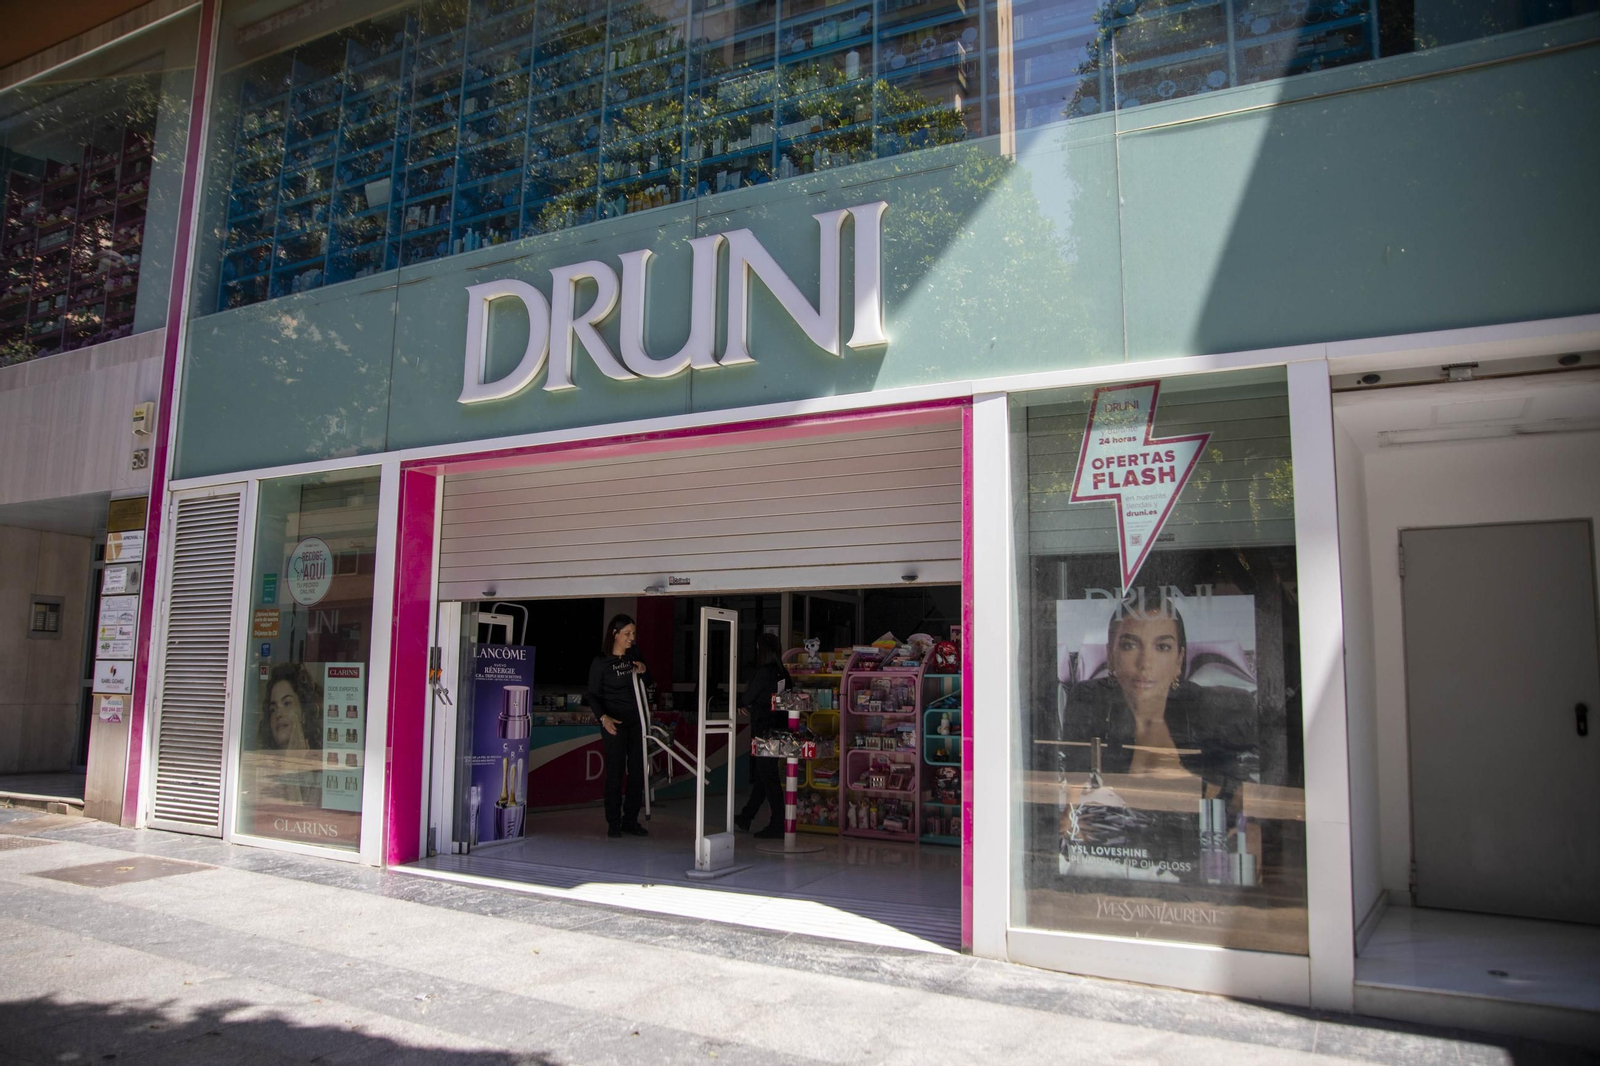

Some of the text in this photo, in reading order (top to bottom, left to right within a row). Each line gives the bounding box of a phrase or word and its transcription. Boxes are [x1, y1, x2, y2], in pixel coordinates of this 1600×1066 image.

[457, 200, 889, 405] DRUNI
[1104, 401, 1139, 413] DRUNI
[132, 451, 146, 468] 53
[1091, 450, 1175, 470] OFERTAS
[1092, 466, 1175, 490] FLASH
[1126, 501, 1152, 509] tiendas
[1126, 509, 1158, 517] druni.es
[302, 551, 323, 561] RECOGE
[303, 558, 327, 581] AQUÍ
[473, 647, 527, 661] LANCÔME
[329, 669, 358, 677] CLARINS
[484, 666, 516, 674] RÉNERGIE
[274, 818, 339, 837] CLARINS
[1070, 845, 1148, 858] YSL LOVESHINE
[1124, 858, 1138, 868] LIP
[1140, 859, 1155, 869] OIL
[1158, 861, 1192, 872] GLOSS
